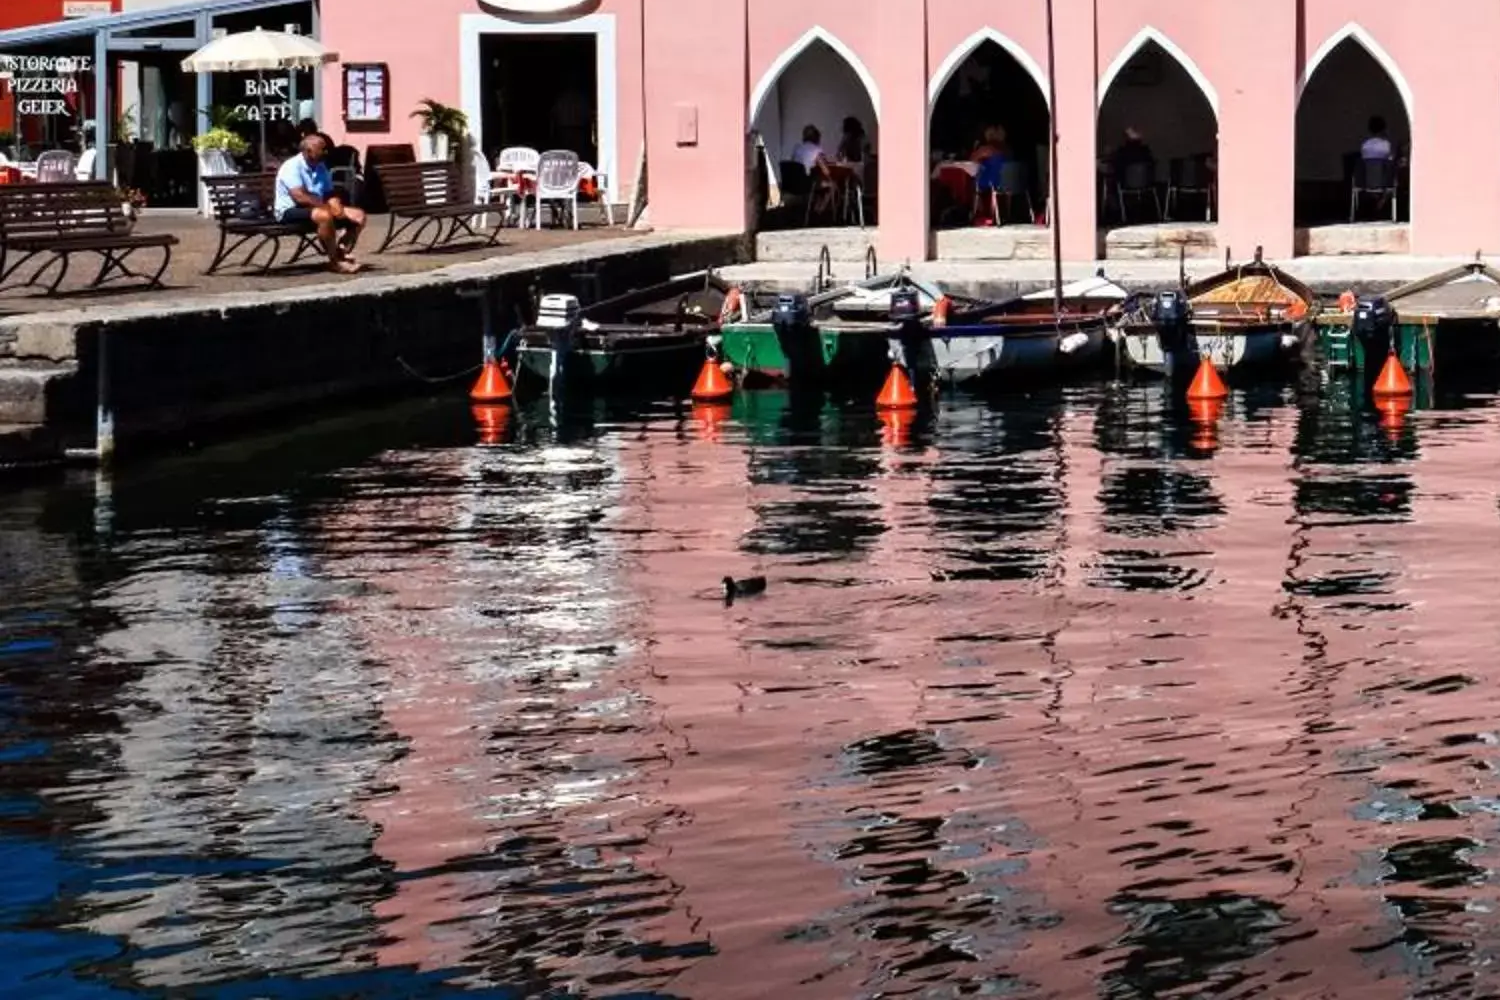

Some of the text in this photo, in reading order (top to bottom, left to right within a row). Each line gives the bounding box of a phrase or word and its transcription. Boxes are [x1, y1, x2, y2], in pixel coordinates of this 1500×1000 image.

[7, 77, 78, 95] PIZZERIA
[245, 78, 289, 99] BAR
[18, 99, 71, 116] GEIER
